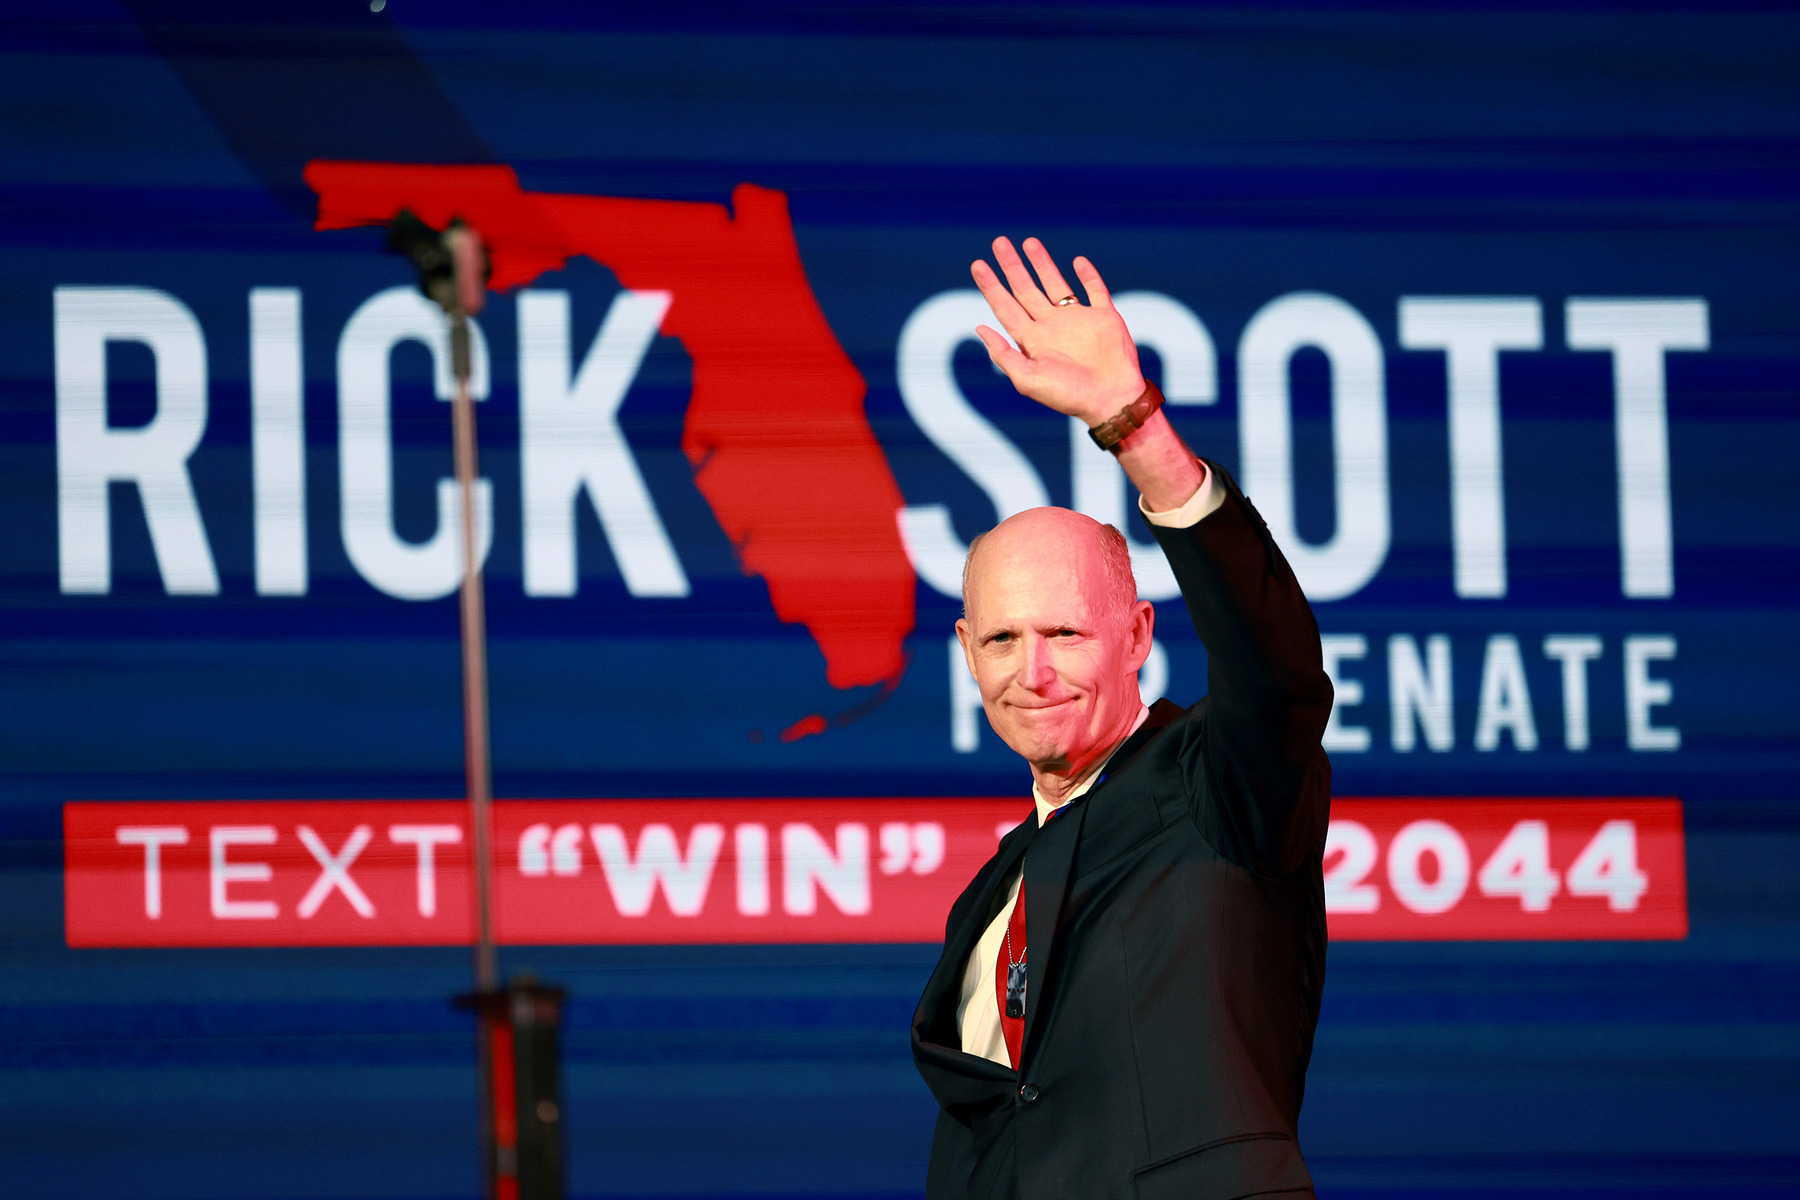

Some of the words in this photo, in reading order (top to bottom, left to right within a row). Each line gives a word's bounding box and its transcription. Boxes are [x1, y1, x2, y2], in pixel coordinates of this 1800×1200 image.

[53, 286, 690, 601] RICK
[895, 288, 1710, 602] SCOTT
[1319, 634, 1681, 752] ENATE
[116, 824, 463, 919] TEXT
[518, 822, 946, 918] “WIN”
